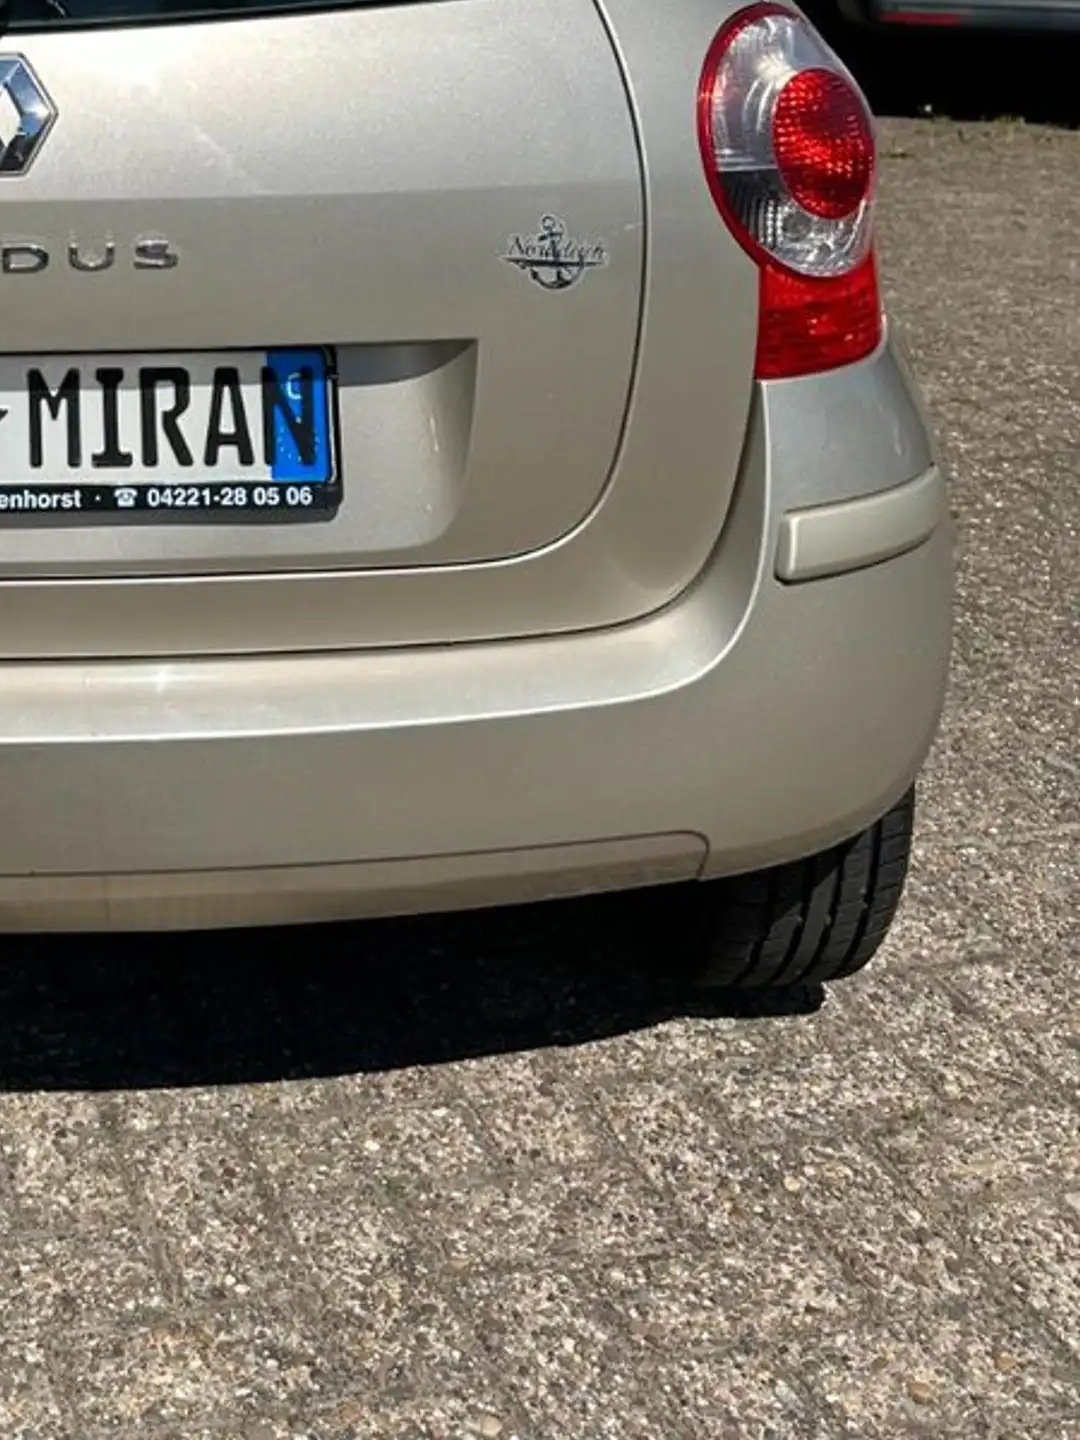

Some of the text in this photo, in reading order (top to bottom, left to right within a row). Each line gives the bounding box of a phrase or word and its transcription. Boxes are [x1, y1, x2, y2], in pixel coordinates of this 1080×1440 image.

[27, 364, 317, 468] MIRAN
[146, 486, 248, 507] 04221-28
[253, 486, 280, 506] 05
[285, 485, 313, 506] 06
